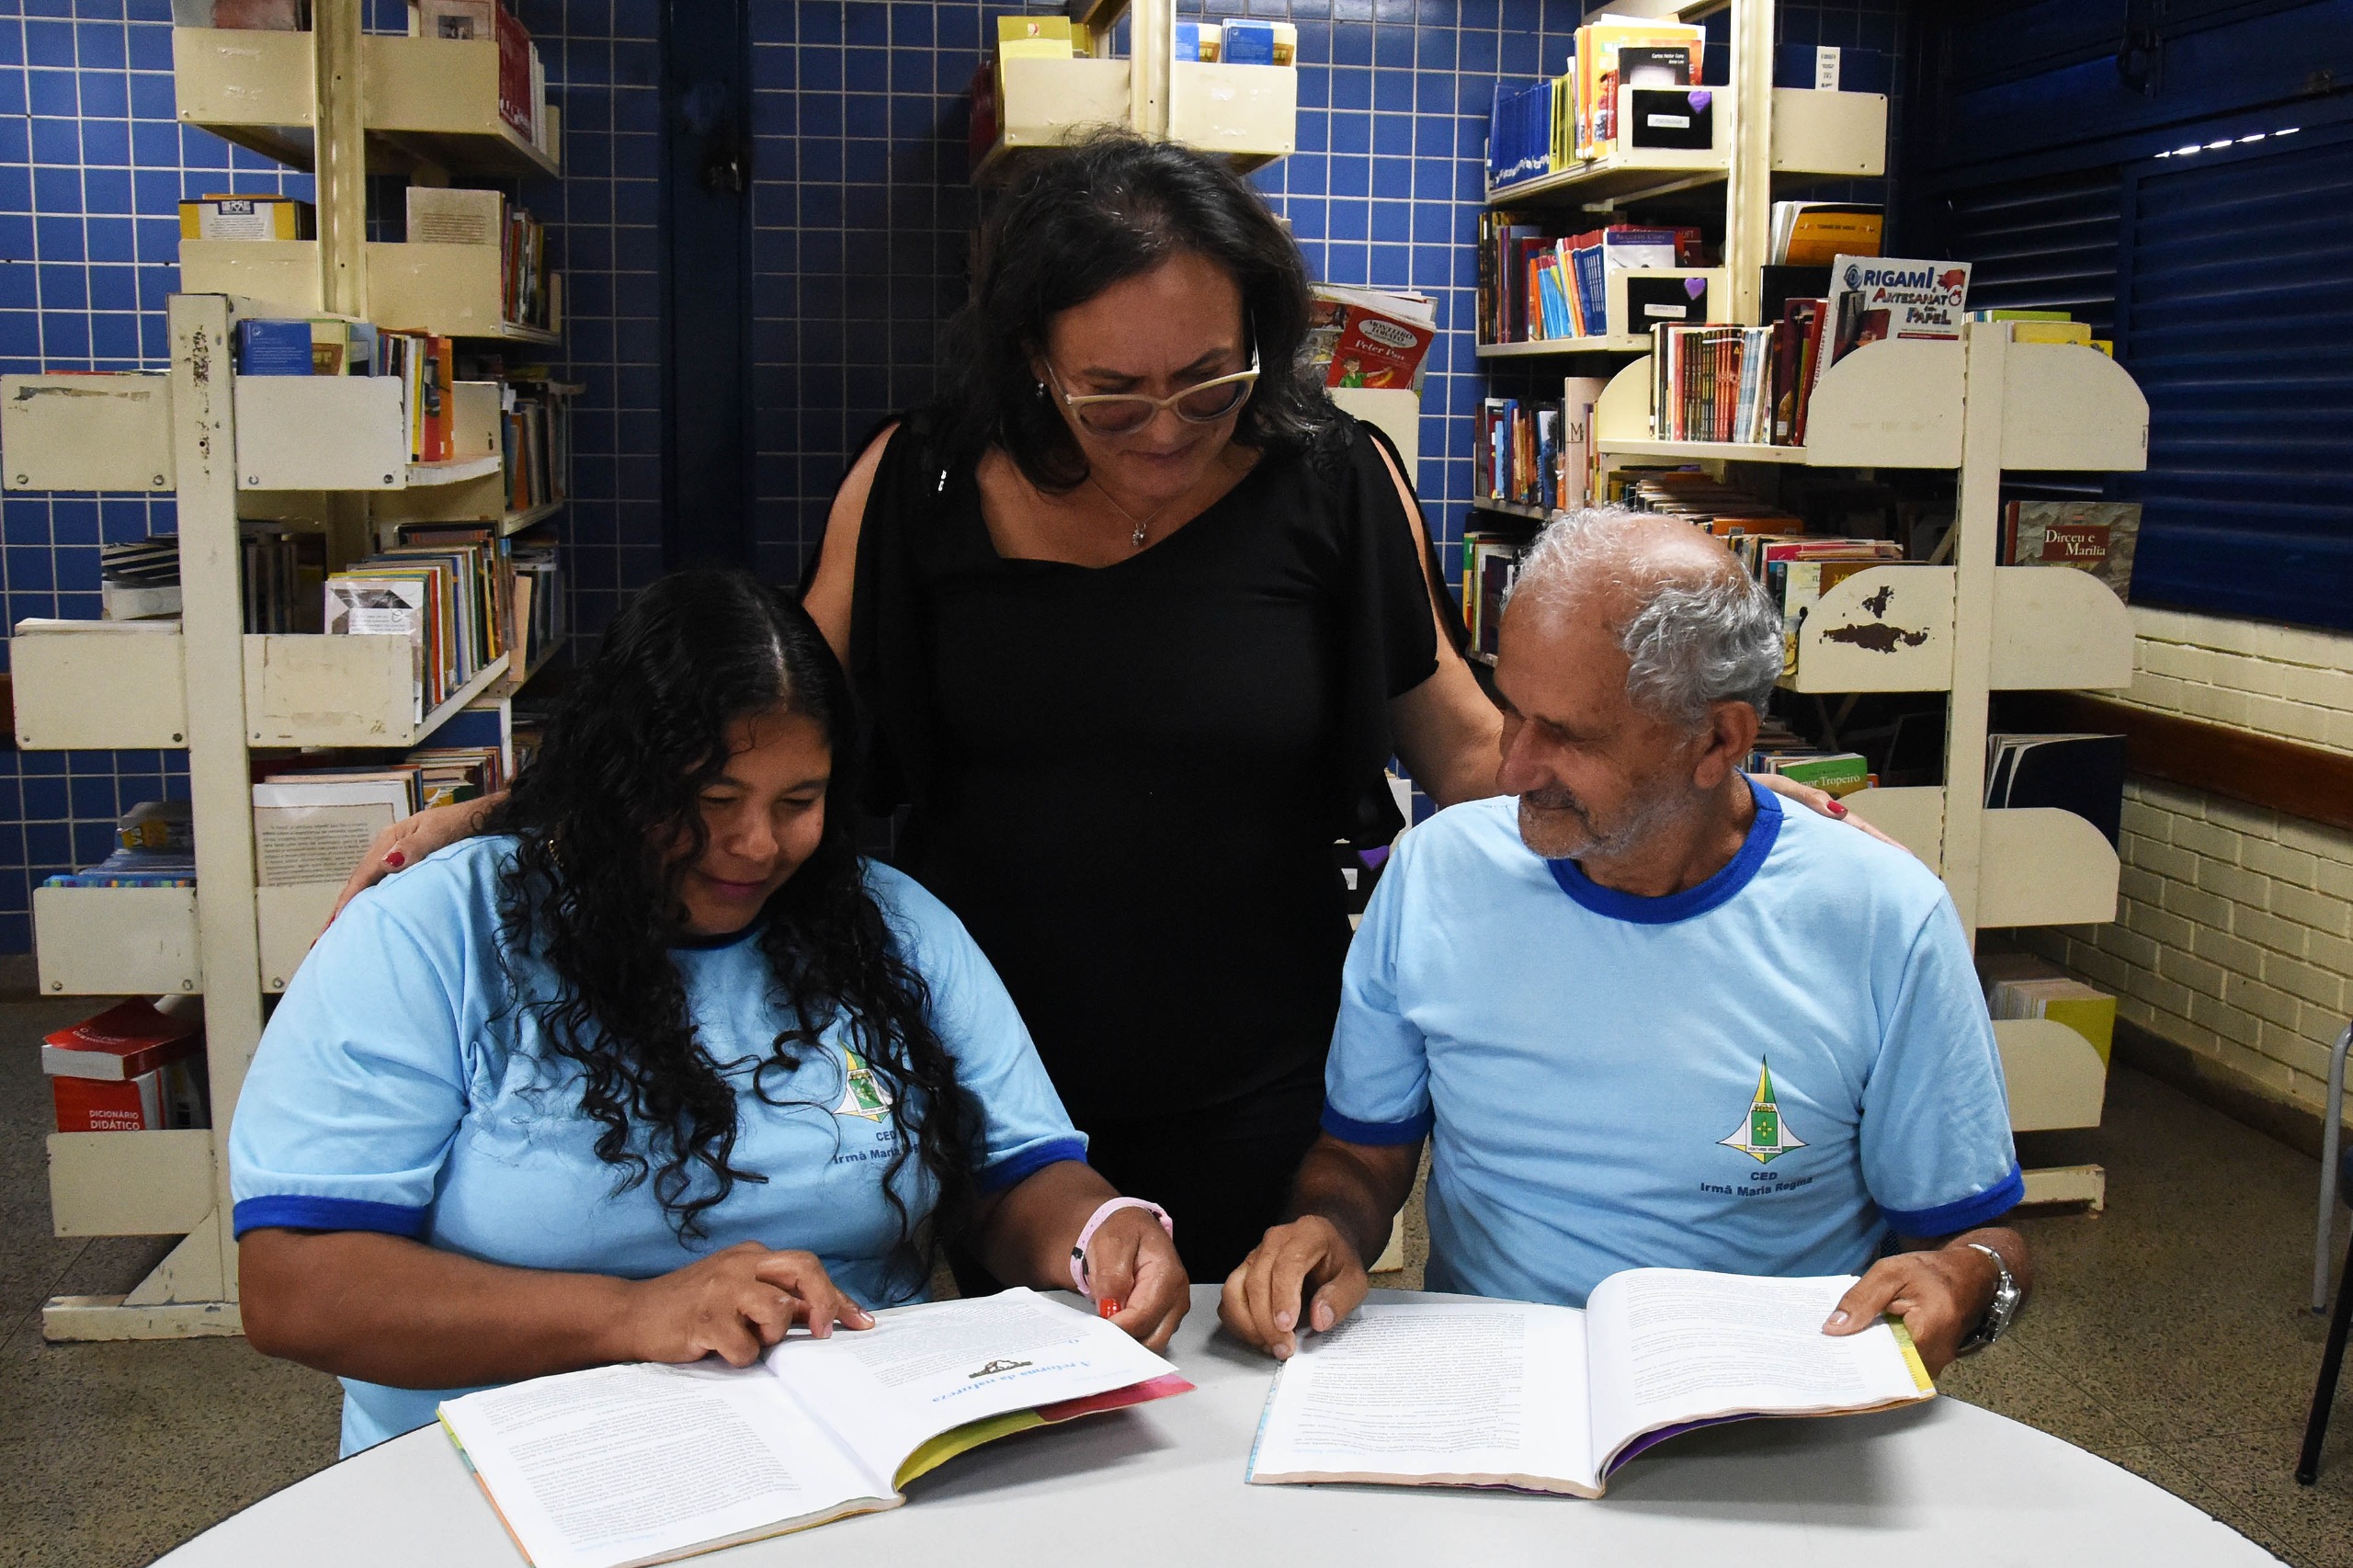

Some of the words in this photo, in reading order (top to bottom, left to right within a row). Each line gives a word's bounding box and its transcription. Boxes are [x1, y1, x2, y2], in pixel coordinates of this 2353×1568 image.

[1355, 339, 1384, 355] Peter
[1385, 348, 1405, 361] Pan
[2045, 529, 2085, 543] Dirceu
[2087, 534, 2096, 542] e
[2065, 542, 2106, 556] Marília
[1800, 778, 1817, 787] mor
[1820, 774, 1860, 787] Tropeiro
[89, 1109, 139, 1119] DICIONÁRIO
[90, 1119, 140, 1131] DIDÁTICO
[876, 1130, 897, 1142] CED
[834, 1151, 867, 1165] Irmã
[1750, 1171, 1778, 1181] CED
[1700, 1182, 1733, 1195] Irmã
[1737, 1185, 1772, 1197] Maria
[1775, 1176, 1813, 1192] Regina
